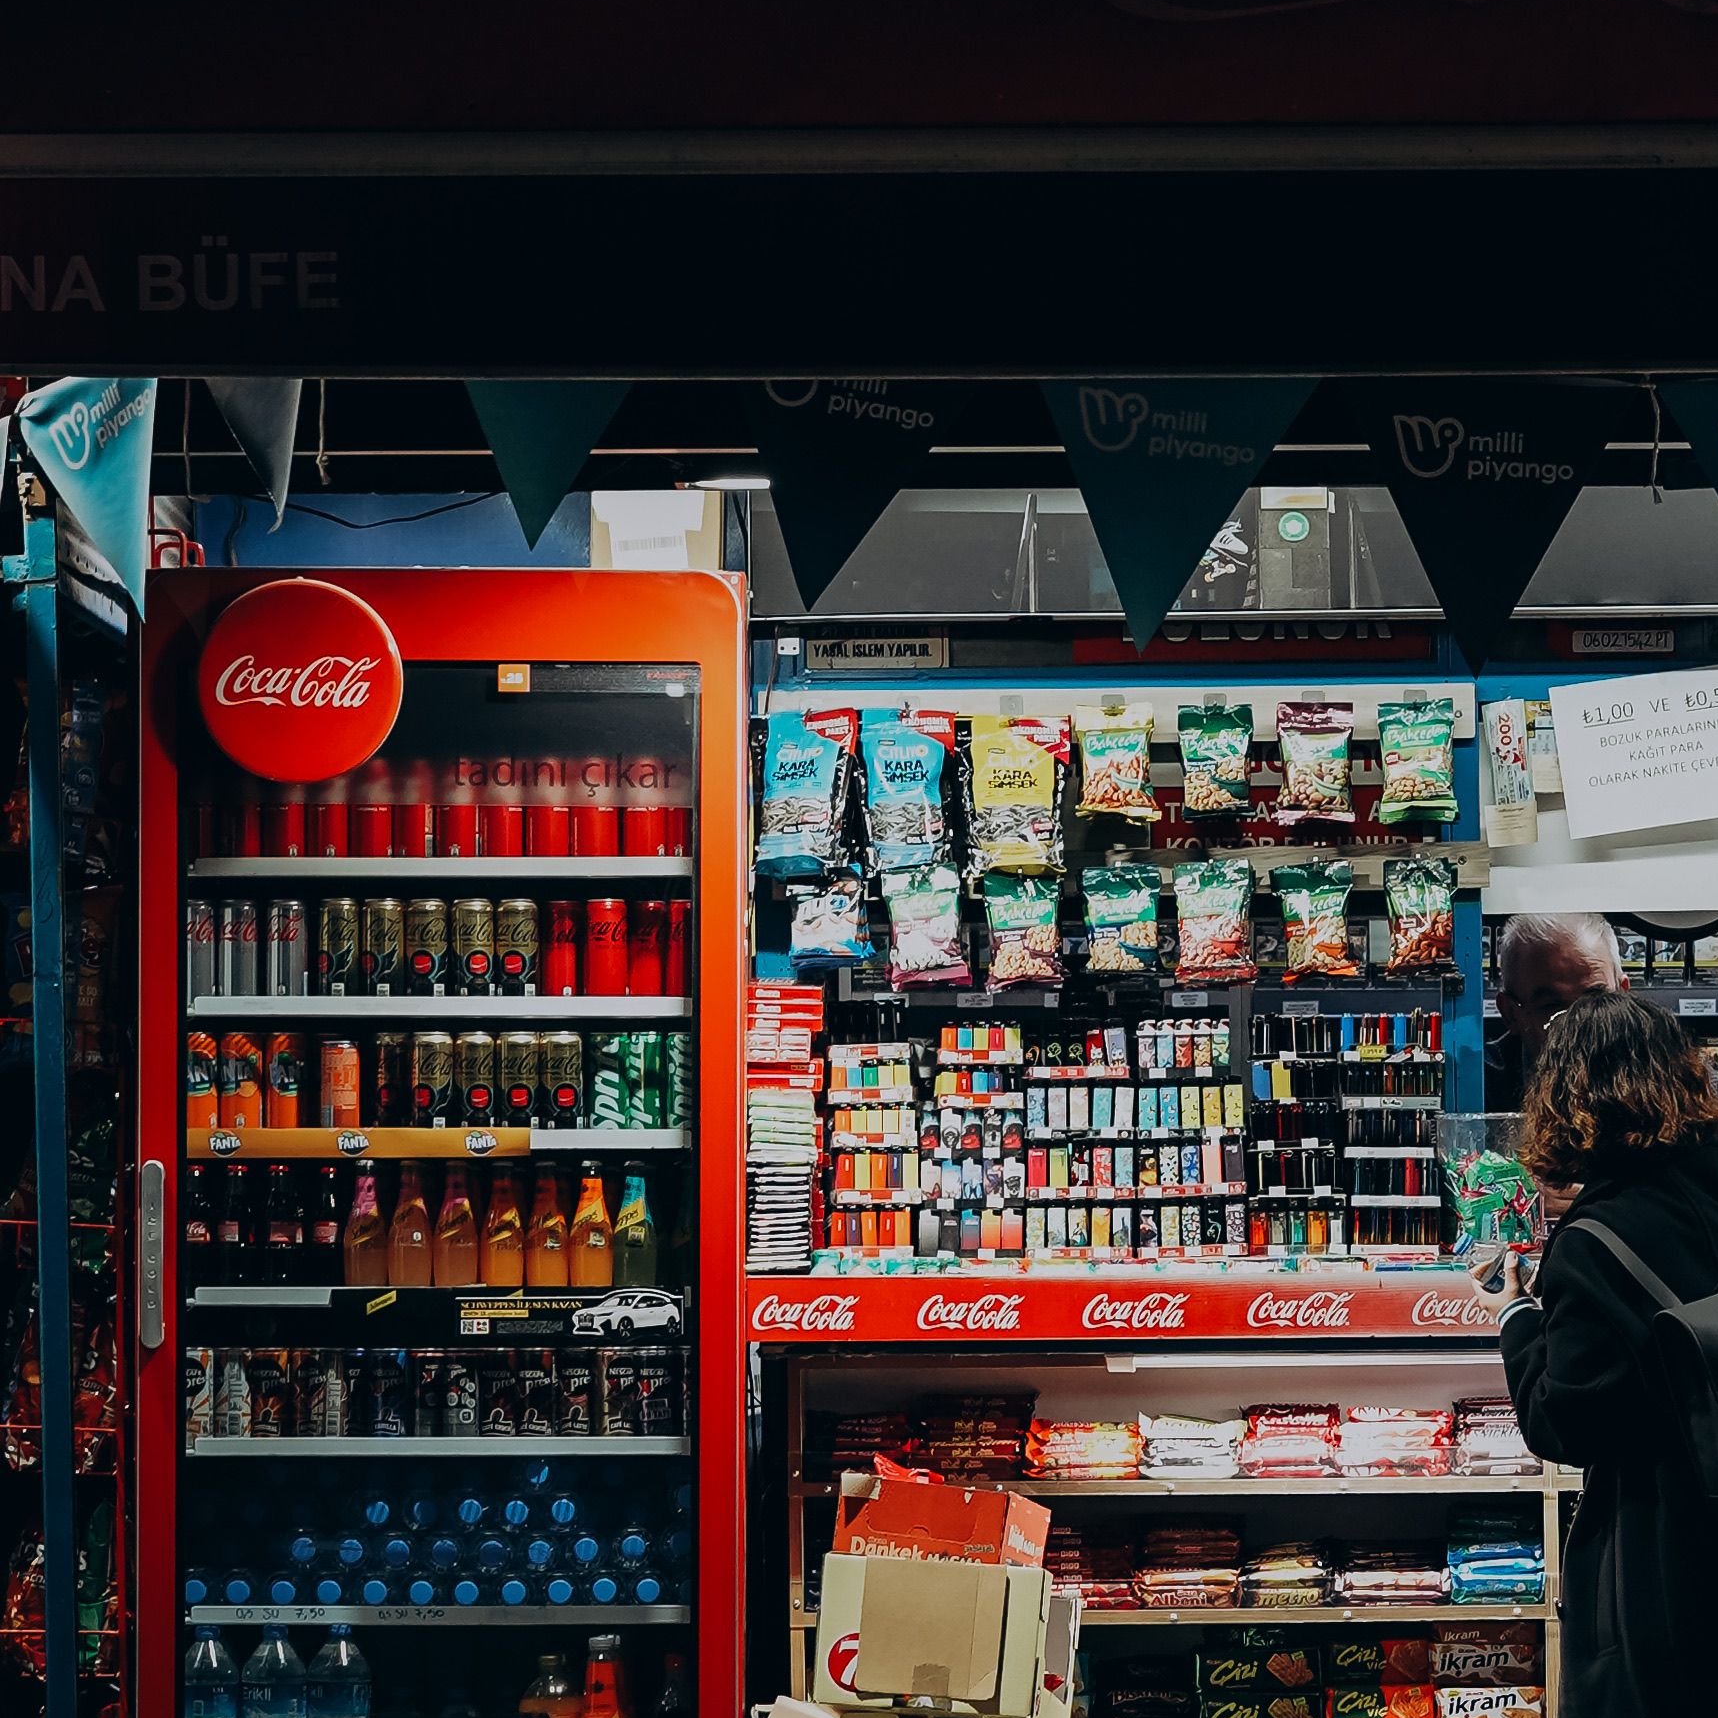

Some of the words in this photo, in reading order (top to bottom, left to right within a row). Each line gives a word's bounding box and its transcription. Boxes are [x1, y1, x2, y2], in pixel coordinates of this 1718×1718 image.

[136, 235, 342, 312] BÜFE
[827, 392, 935, 430] piyango
[1152, 409, 1209, 434] milli
[1148, 434, 1256, 467] piyango
[1468, 433, 1524, 455] milli
[1467, 458, 1574, 482] piyango
[215, 654, 382, 708] Coca-Cola
[1649, 698, 1670, 713] VE
[1600, 731, 1642, 748] BOZUK
[1629, 745, 1665, 762] KAĞIT
[1670, 741, 1704, 755] PARA
[453, 753, 567, 789] tadını
[580, 753, 678, 798] çıkar
[1589, 770, 1639, 788] OLARAK
[209, 1132, 241, 1151] FANTA
[337, 1131, 370, 1151] FANTA
[465, 1131, 498, 1150] FANTA
[752, 1294, 860, 1330] Coca-Cola
[917, 1293, 1025, 1330] Coca-Cola
[1082, 1291, 1191, 1329] Coca-Cola
[1247, 1291, 1355, 1328] Coca-Cola
[1412, 1290, 1498, 1326] Coca-Co
[1440, 1650, 1510, 1673] ikram
[1448, 1692, 1518, 1716] ikram
